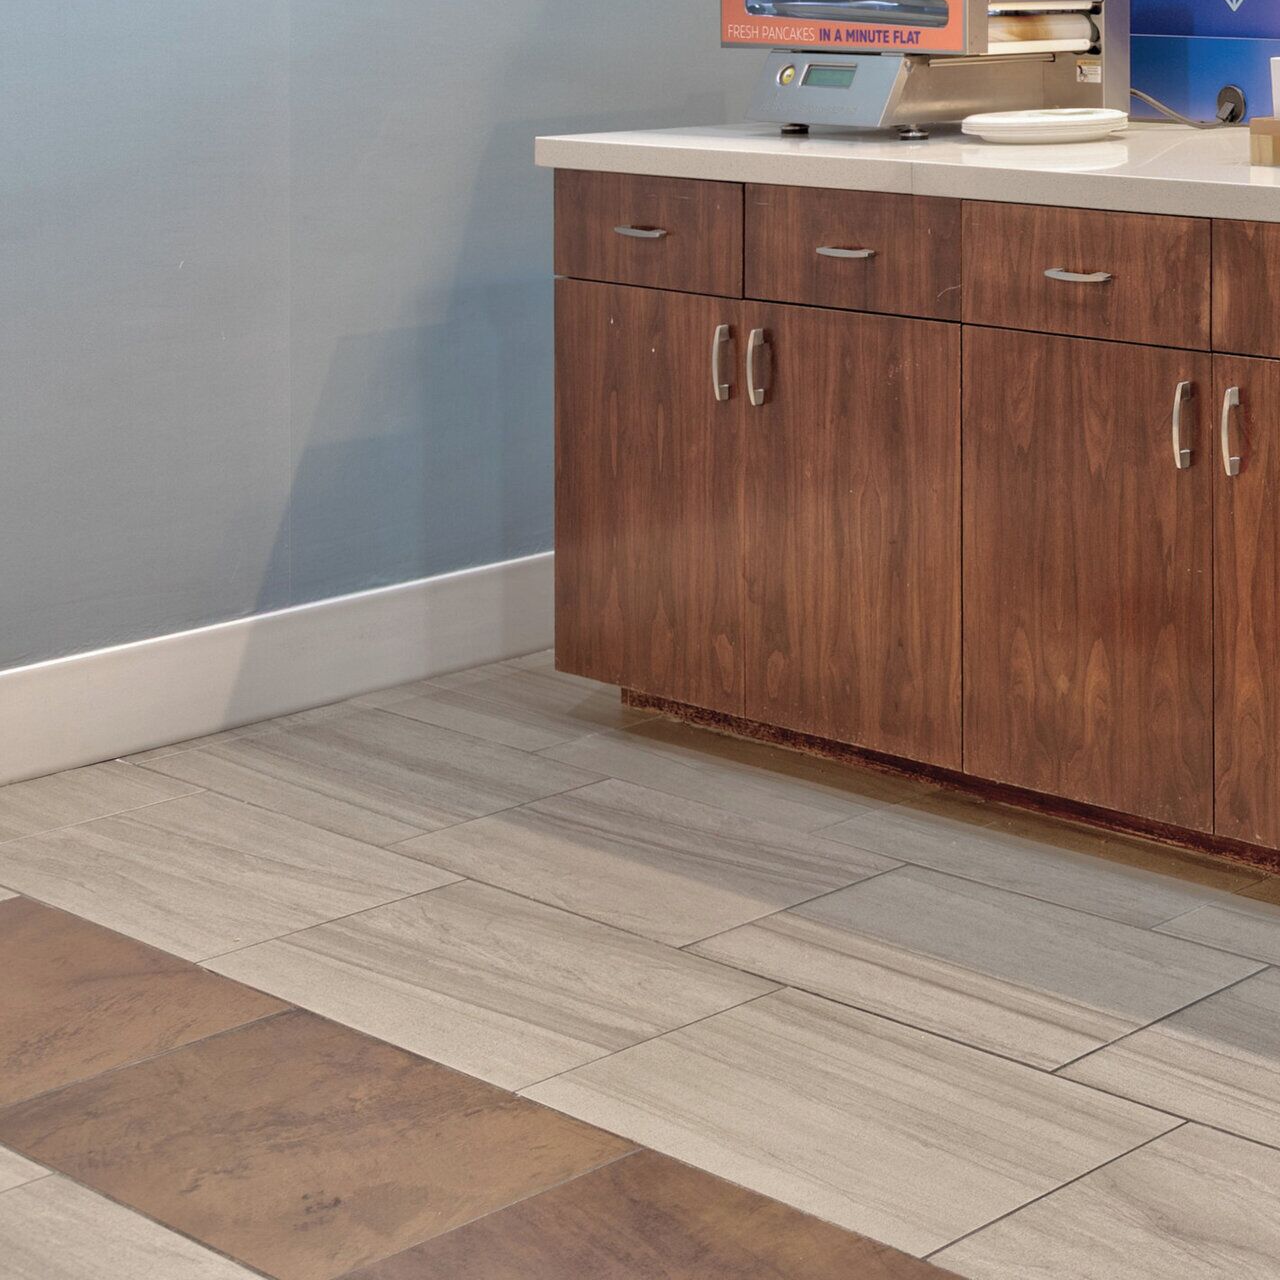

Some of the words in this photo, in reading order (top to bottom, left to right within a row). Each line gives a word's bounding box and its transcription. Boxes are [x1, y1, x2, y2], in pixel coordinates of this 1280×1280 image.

[728, 24, 759, 39] FRESH
[762, 26, 815, 41] PANCAKES
[819, 28, 831, 41] IN
[834, 29, 842, 42] A
[845, 29, 889, 43] MINUTE
[894, 31, 921, 44] FLAT
